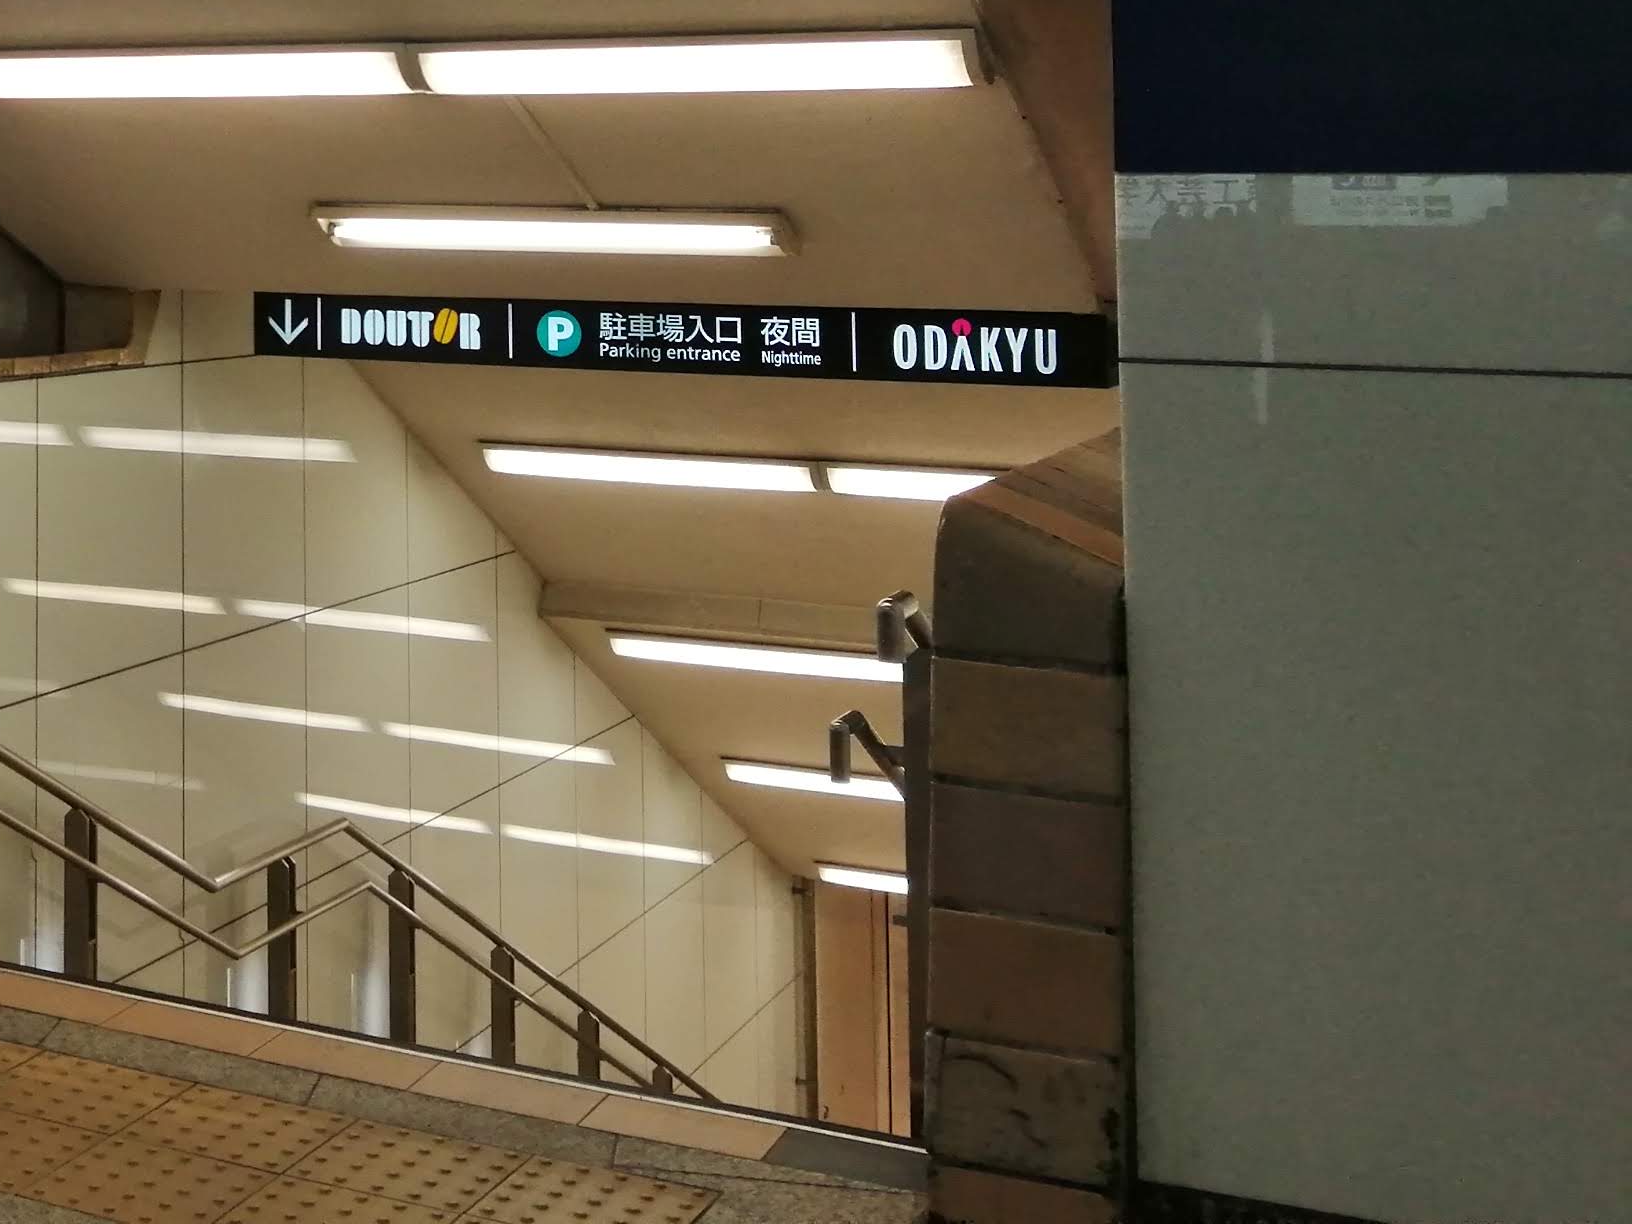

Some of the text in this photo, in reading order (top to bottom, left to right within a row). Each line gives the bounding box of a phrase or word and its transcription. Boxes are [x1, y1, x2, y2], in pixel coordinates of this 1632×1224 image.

[340, 307, 482, 350] DOUTOR
[599, 312, 820, 347] 駐車場入口 夜間
[599, 342, 822, 367] Parking entrance Nighttime
[892, 322, 1058, 375] ODAKYU
